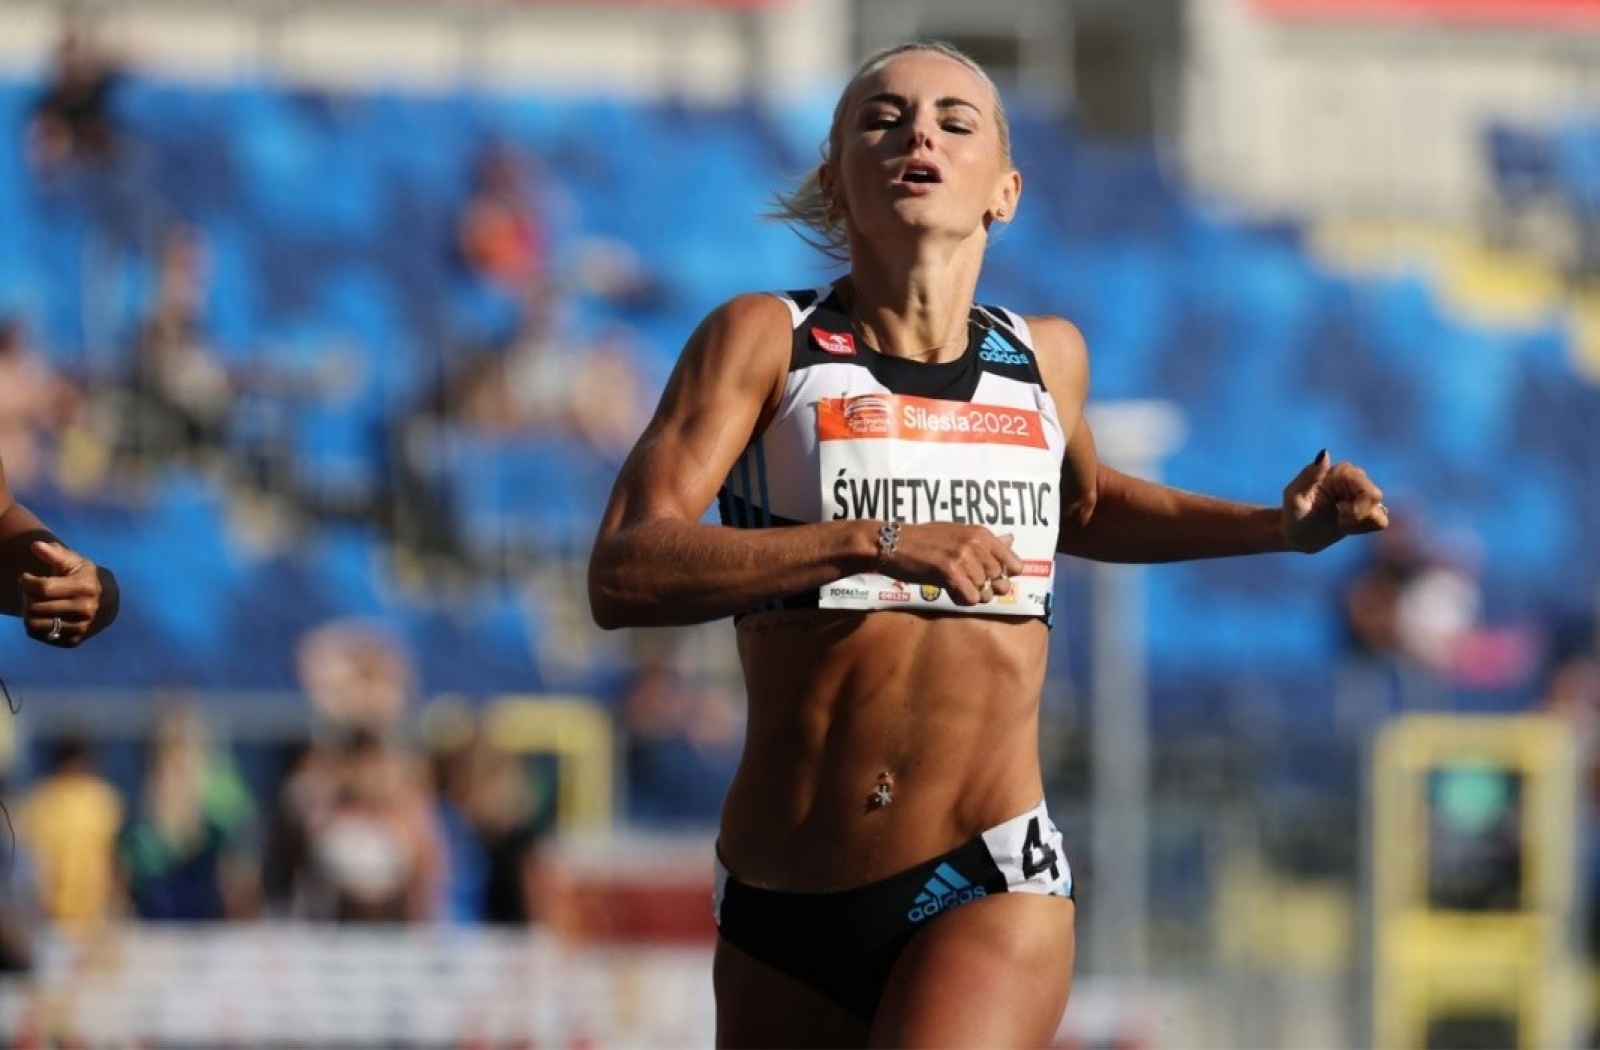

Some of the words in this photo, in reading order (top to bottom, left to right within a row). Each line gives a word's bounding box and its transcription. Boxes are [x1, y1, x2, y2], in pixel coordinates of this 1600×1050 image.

[979, 351, 1029, 365] adidas
[1021, 816, 1060, 880] 4
[908, 885, 987, 922] adidas
